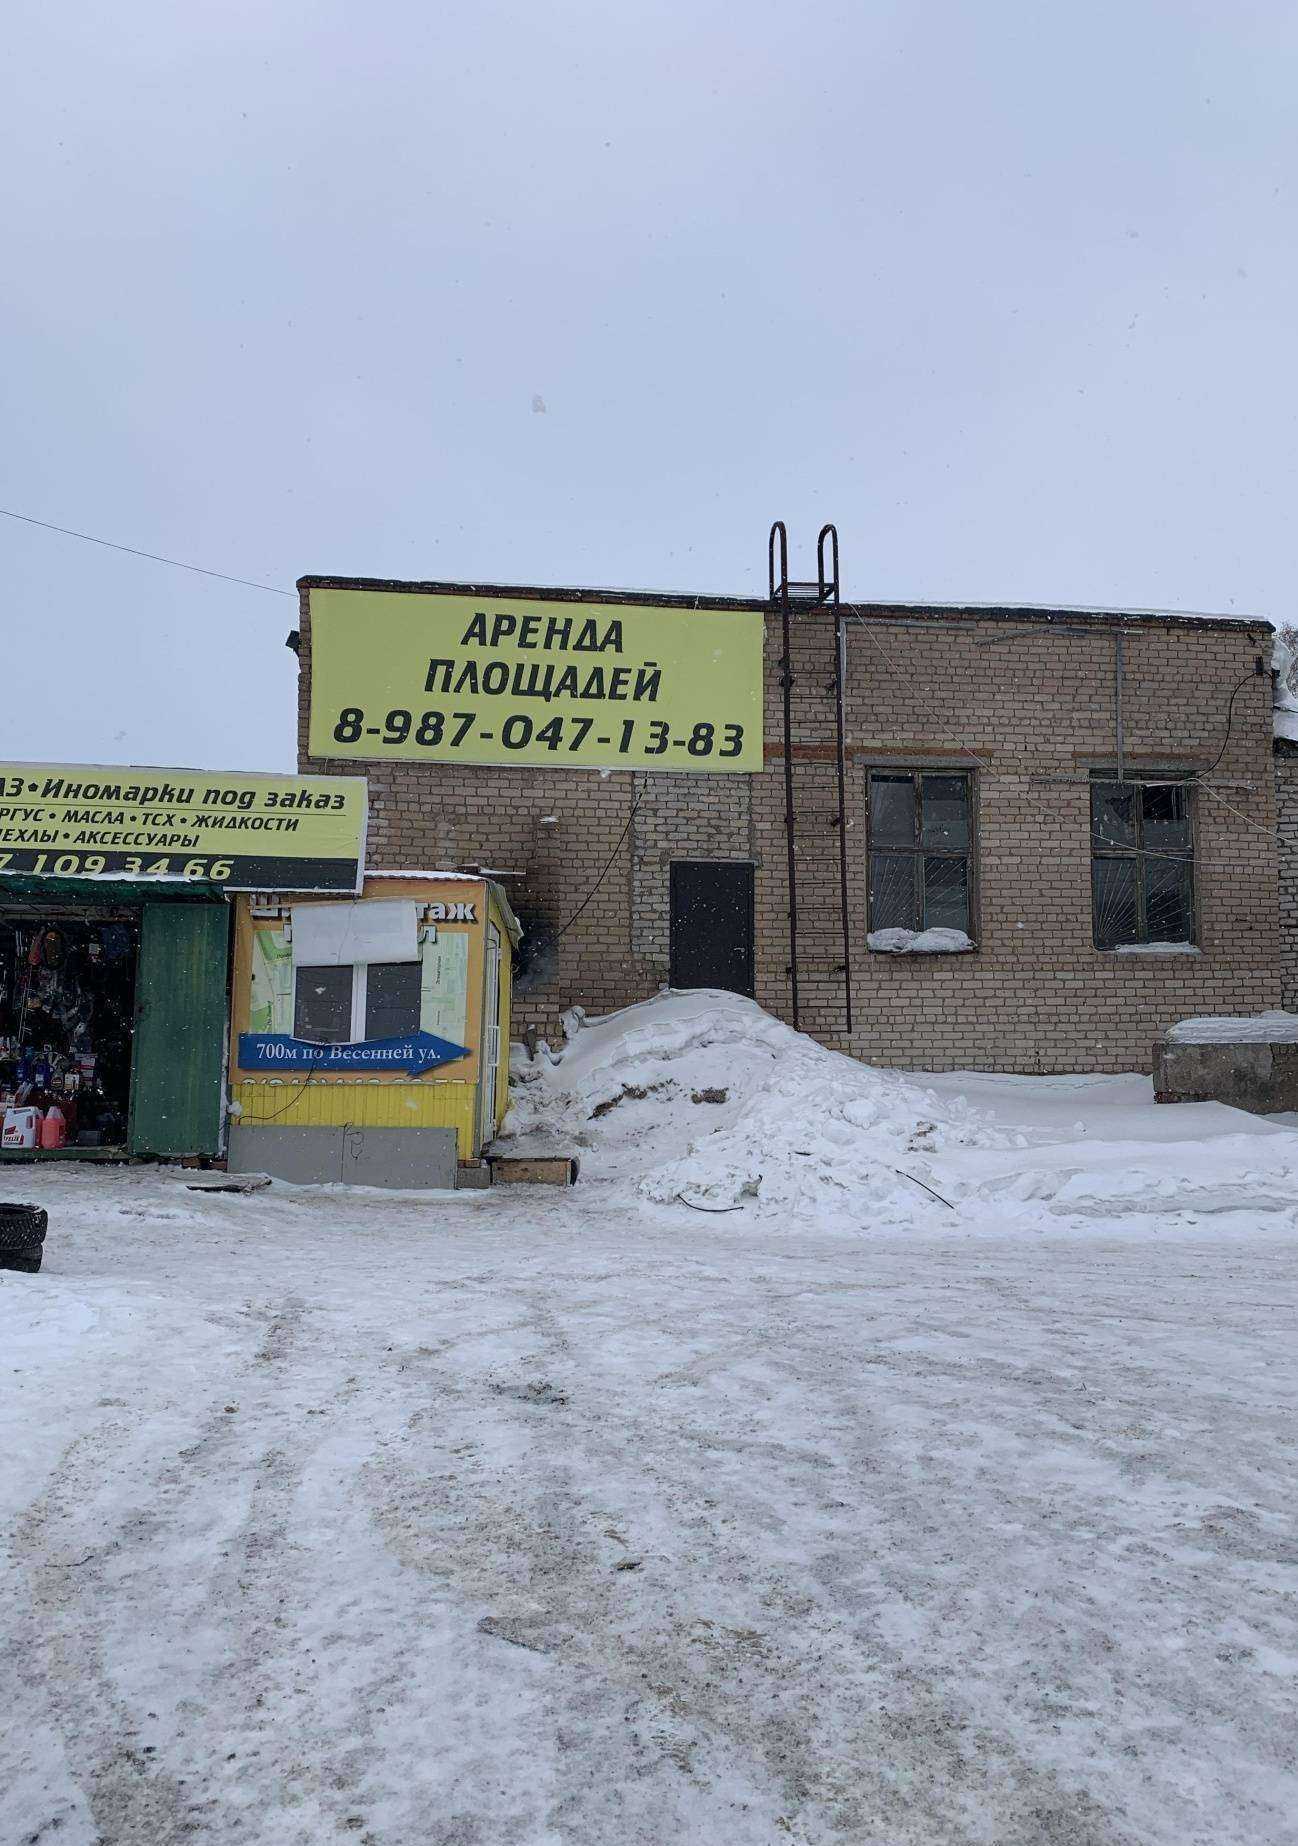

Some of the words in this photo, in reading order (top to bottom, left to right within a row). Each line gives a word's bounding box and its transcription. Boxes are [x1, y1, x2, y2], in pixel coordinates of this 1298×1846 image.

[461, 613, 624, 653] АРЕНДА
[424, 658, 662, 702] ПЛОЩАДЕЙ
[333, 707, 744, 757] 8-987-047-13-83
[40, 778, 195, 805] Иномарки
[202, 788, 257, 810] под
[263, 789, 346, 810] заказ
[61, 810, 125, 825] МАСЛА
[142, 812, 174, 827] ТСХ
[191, 814, 300, 832] ЖИДКОСТИ
[0, 828, 59, 843] ЕХЛЫ
[73, 830, 200, 848] АКСЕССУАРЫ
[33, 854, 106, 876] 109
[183, 859, 235, 881] 66
[256, 1043, 297, 1059] 700м
[302, 1048, 324, 1059] по
[329, 1044, 414, 1060] Весенней
[418, 1049, 441, 1062] ул.
